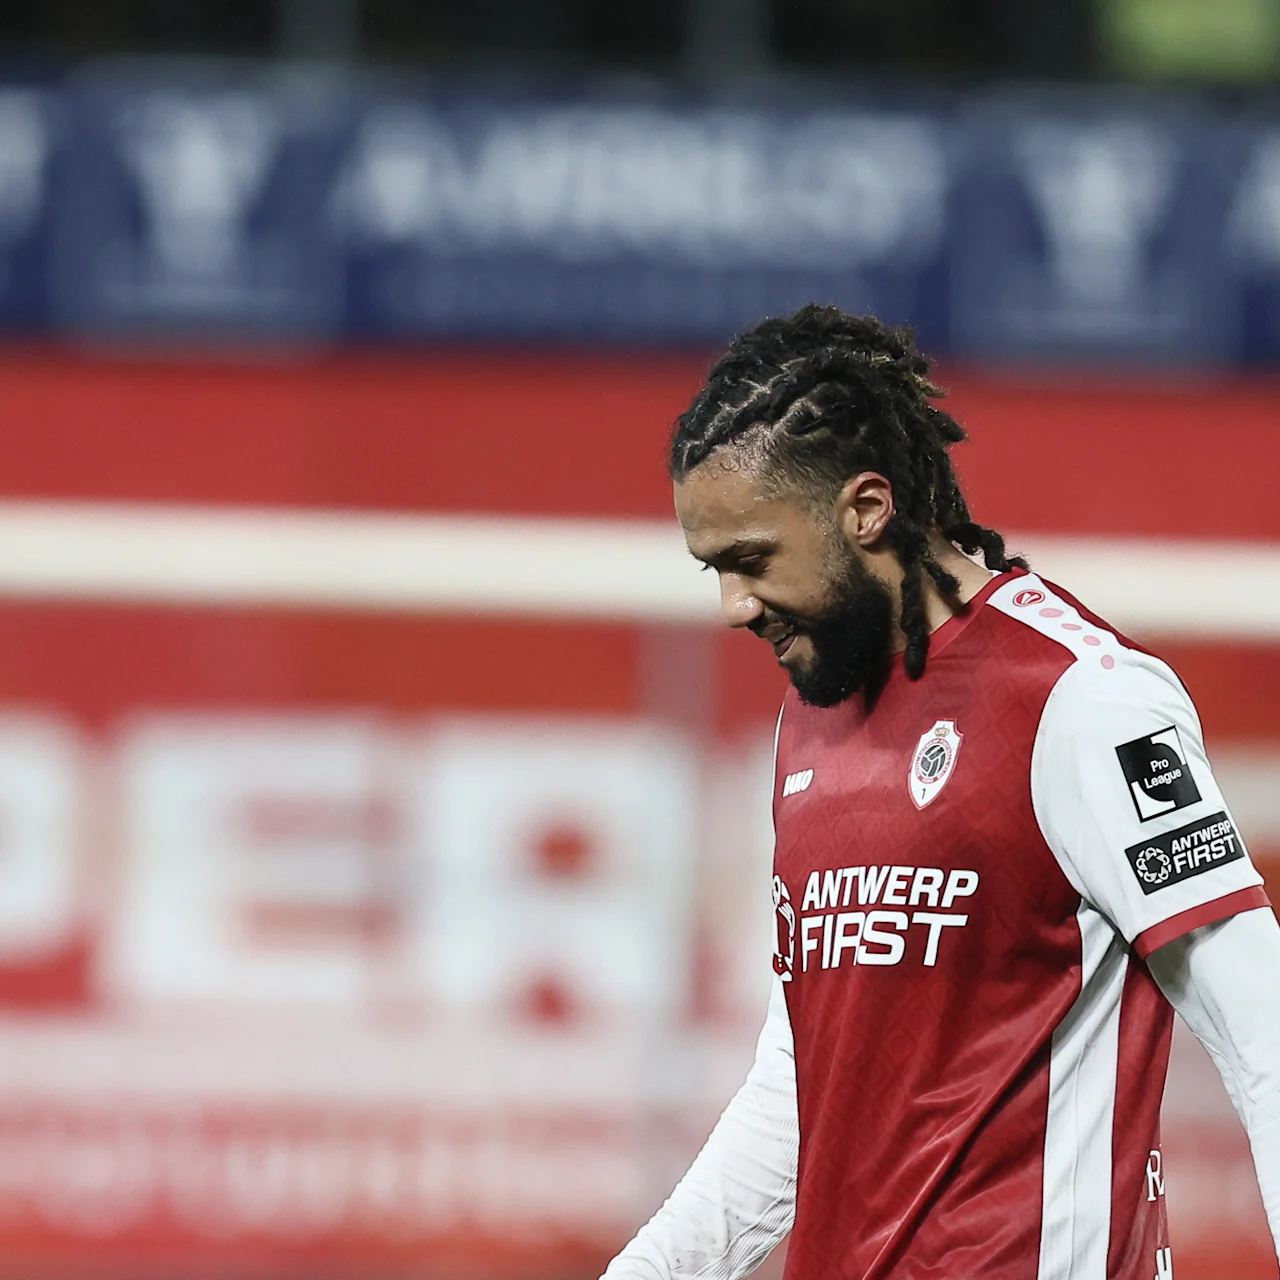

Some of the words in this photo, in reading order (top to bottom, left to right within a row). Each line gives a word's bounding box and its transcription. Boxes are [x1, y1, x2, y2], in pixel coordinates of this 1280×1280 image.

[1144, 768, 1182, 789] League
[1150, 758, 1169, 772] Pro
[1171, 820, 1232, 854] ANTWERP
[1173, 834, 1235, 874] FIRST
[801, 865, 980, 911] ANTWERP
[801, 910, 969, 972] FIRST
